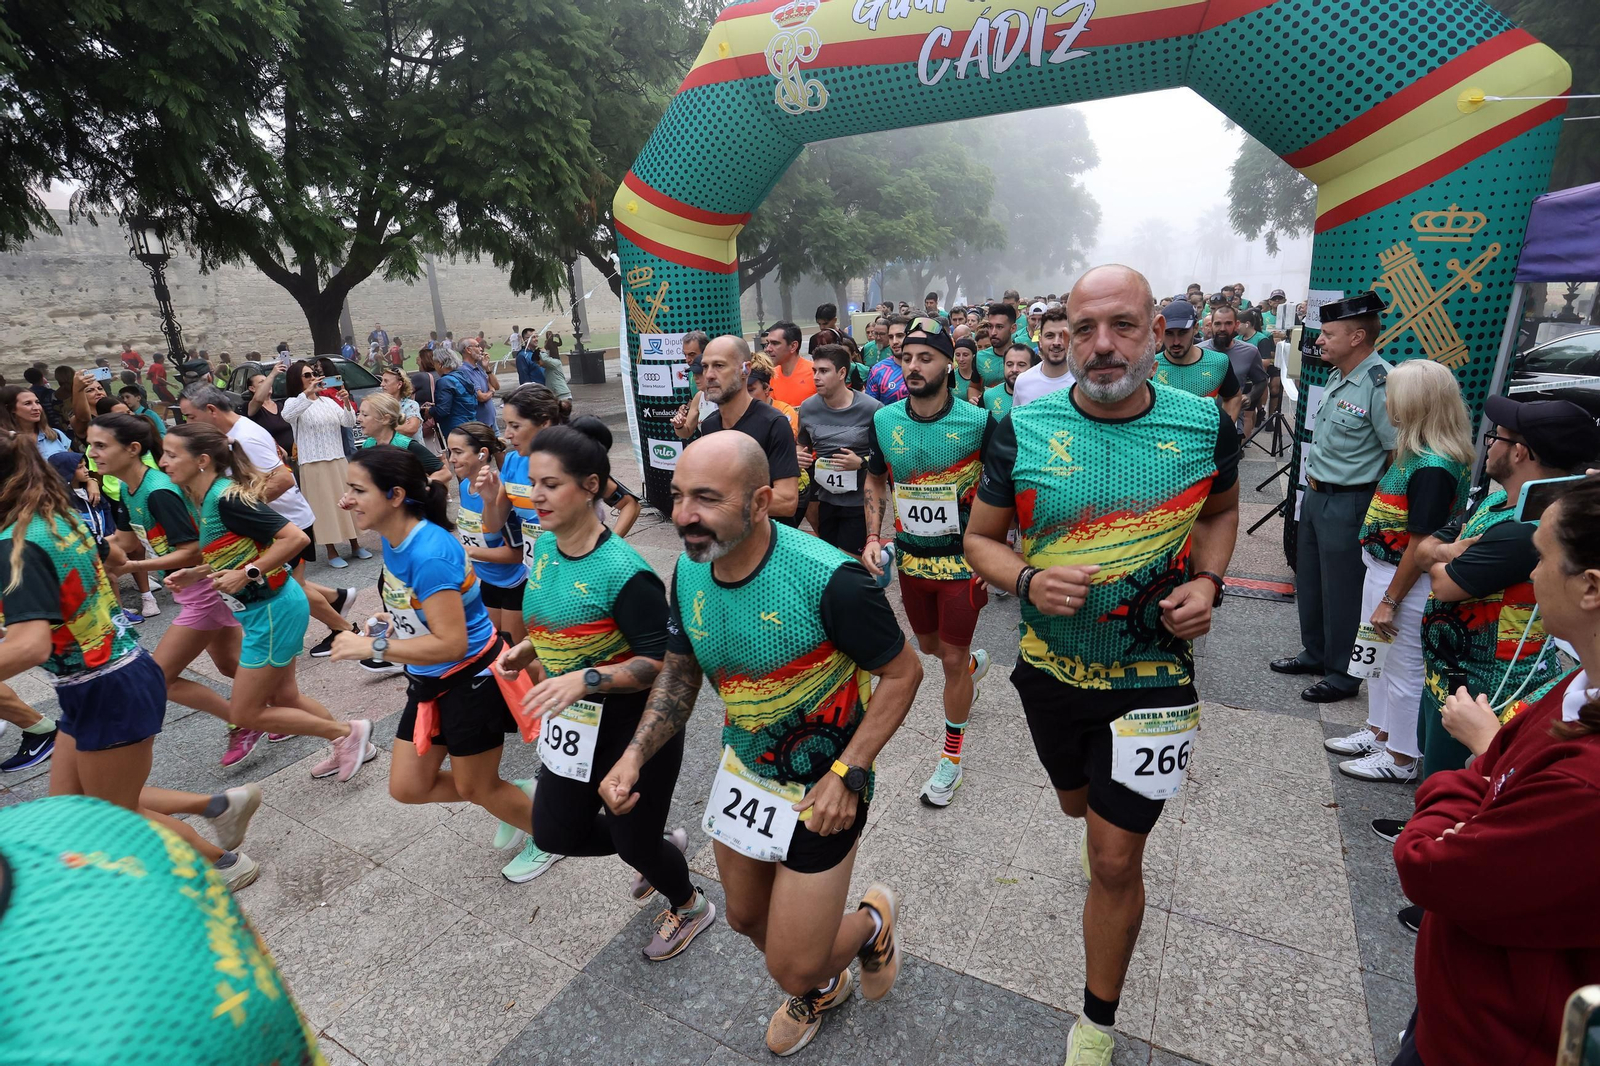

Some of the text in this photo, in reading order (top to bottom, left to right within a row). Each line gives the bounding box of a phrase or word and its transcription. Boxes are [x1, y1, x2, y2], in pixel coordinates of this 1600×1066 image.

[917, 0, 1096, 86] CÁDIZ
[665, 338, 682, 346] Diput
[826, 474, 844, 488] 41
[908, 506, 948, 524] 404
[1122, 705, 1198, 720] CARRERA SOLIDARIA
[1134, 740, 1190, 776] 266
[722, 788, 776, 838] 241
